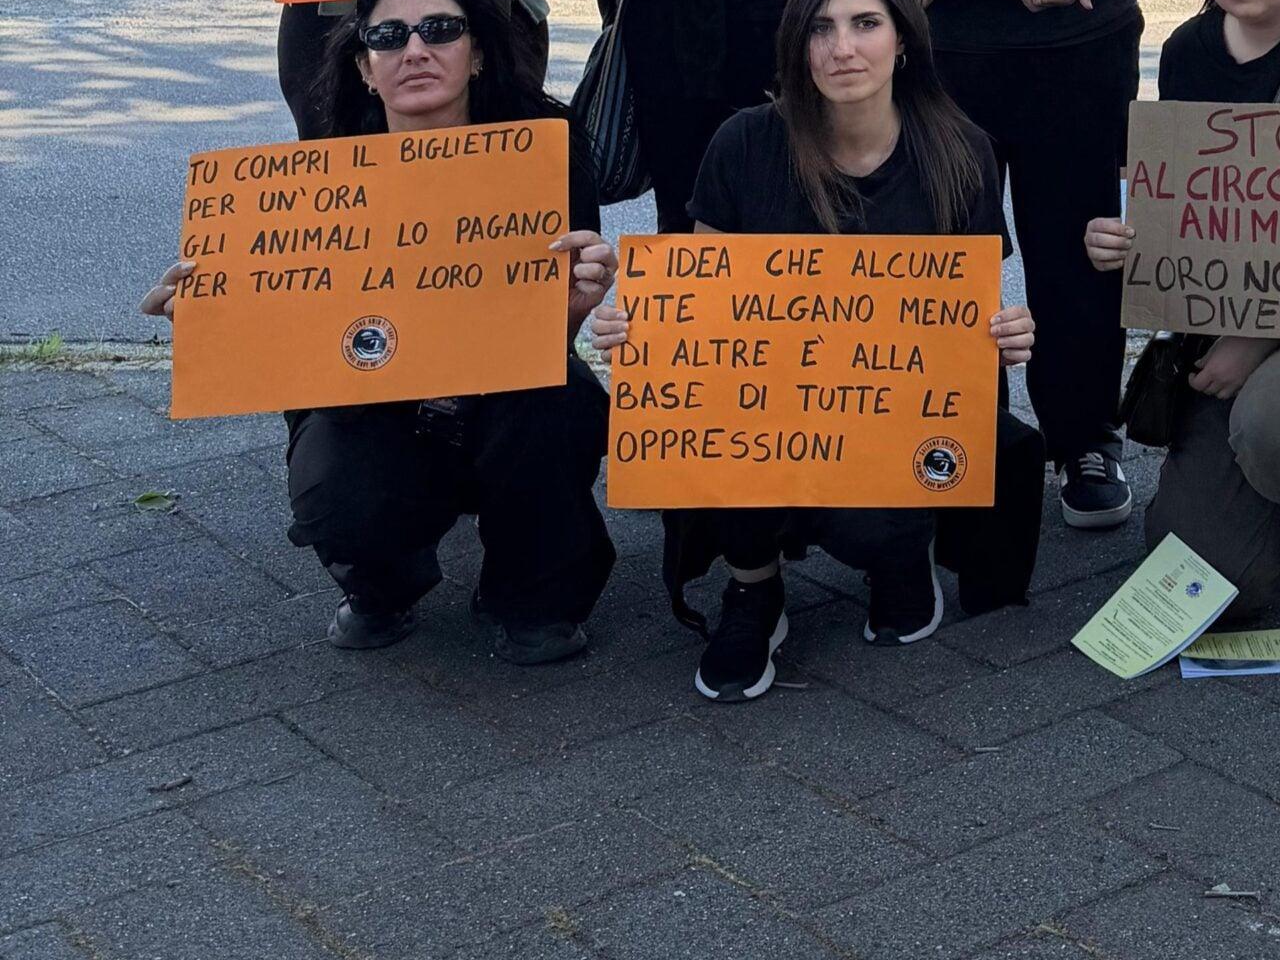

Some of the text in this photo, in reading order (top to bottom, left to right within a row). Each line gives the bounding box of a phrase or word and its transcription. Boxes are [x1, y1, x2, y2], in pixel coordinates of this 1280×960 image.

[189, 127, 533, 187] TU COMPRI IL BIGLIETTO
[1130, 160, 1175, 199] AL
[188, 193, 236, 221] PER
[184, 210, 562, 258] GLI ANIMALI LO PAGANO
[175, 257, 560, 299] PER TUTTA LA LORO VITA
[765, 248, 824, 278] CHE
[851, 249, 968, 280] ALCUNE
[1127, 252, 1228, 291] LORO
[623, 293, 979, 328] VITE VALGANO MENO
[619, 339, 648, 367] DI
[671, 338, 771, 369] ALTRE
[851, 342, 924, 374] ALLA
[616, 381, 962, 419] BASE DI TUTTE LE
[616, 428, 845, 463] OPPRESSIONI
